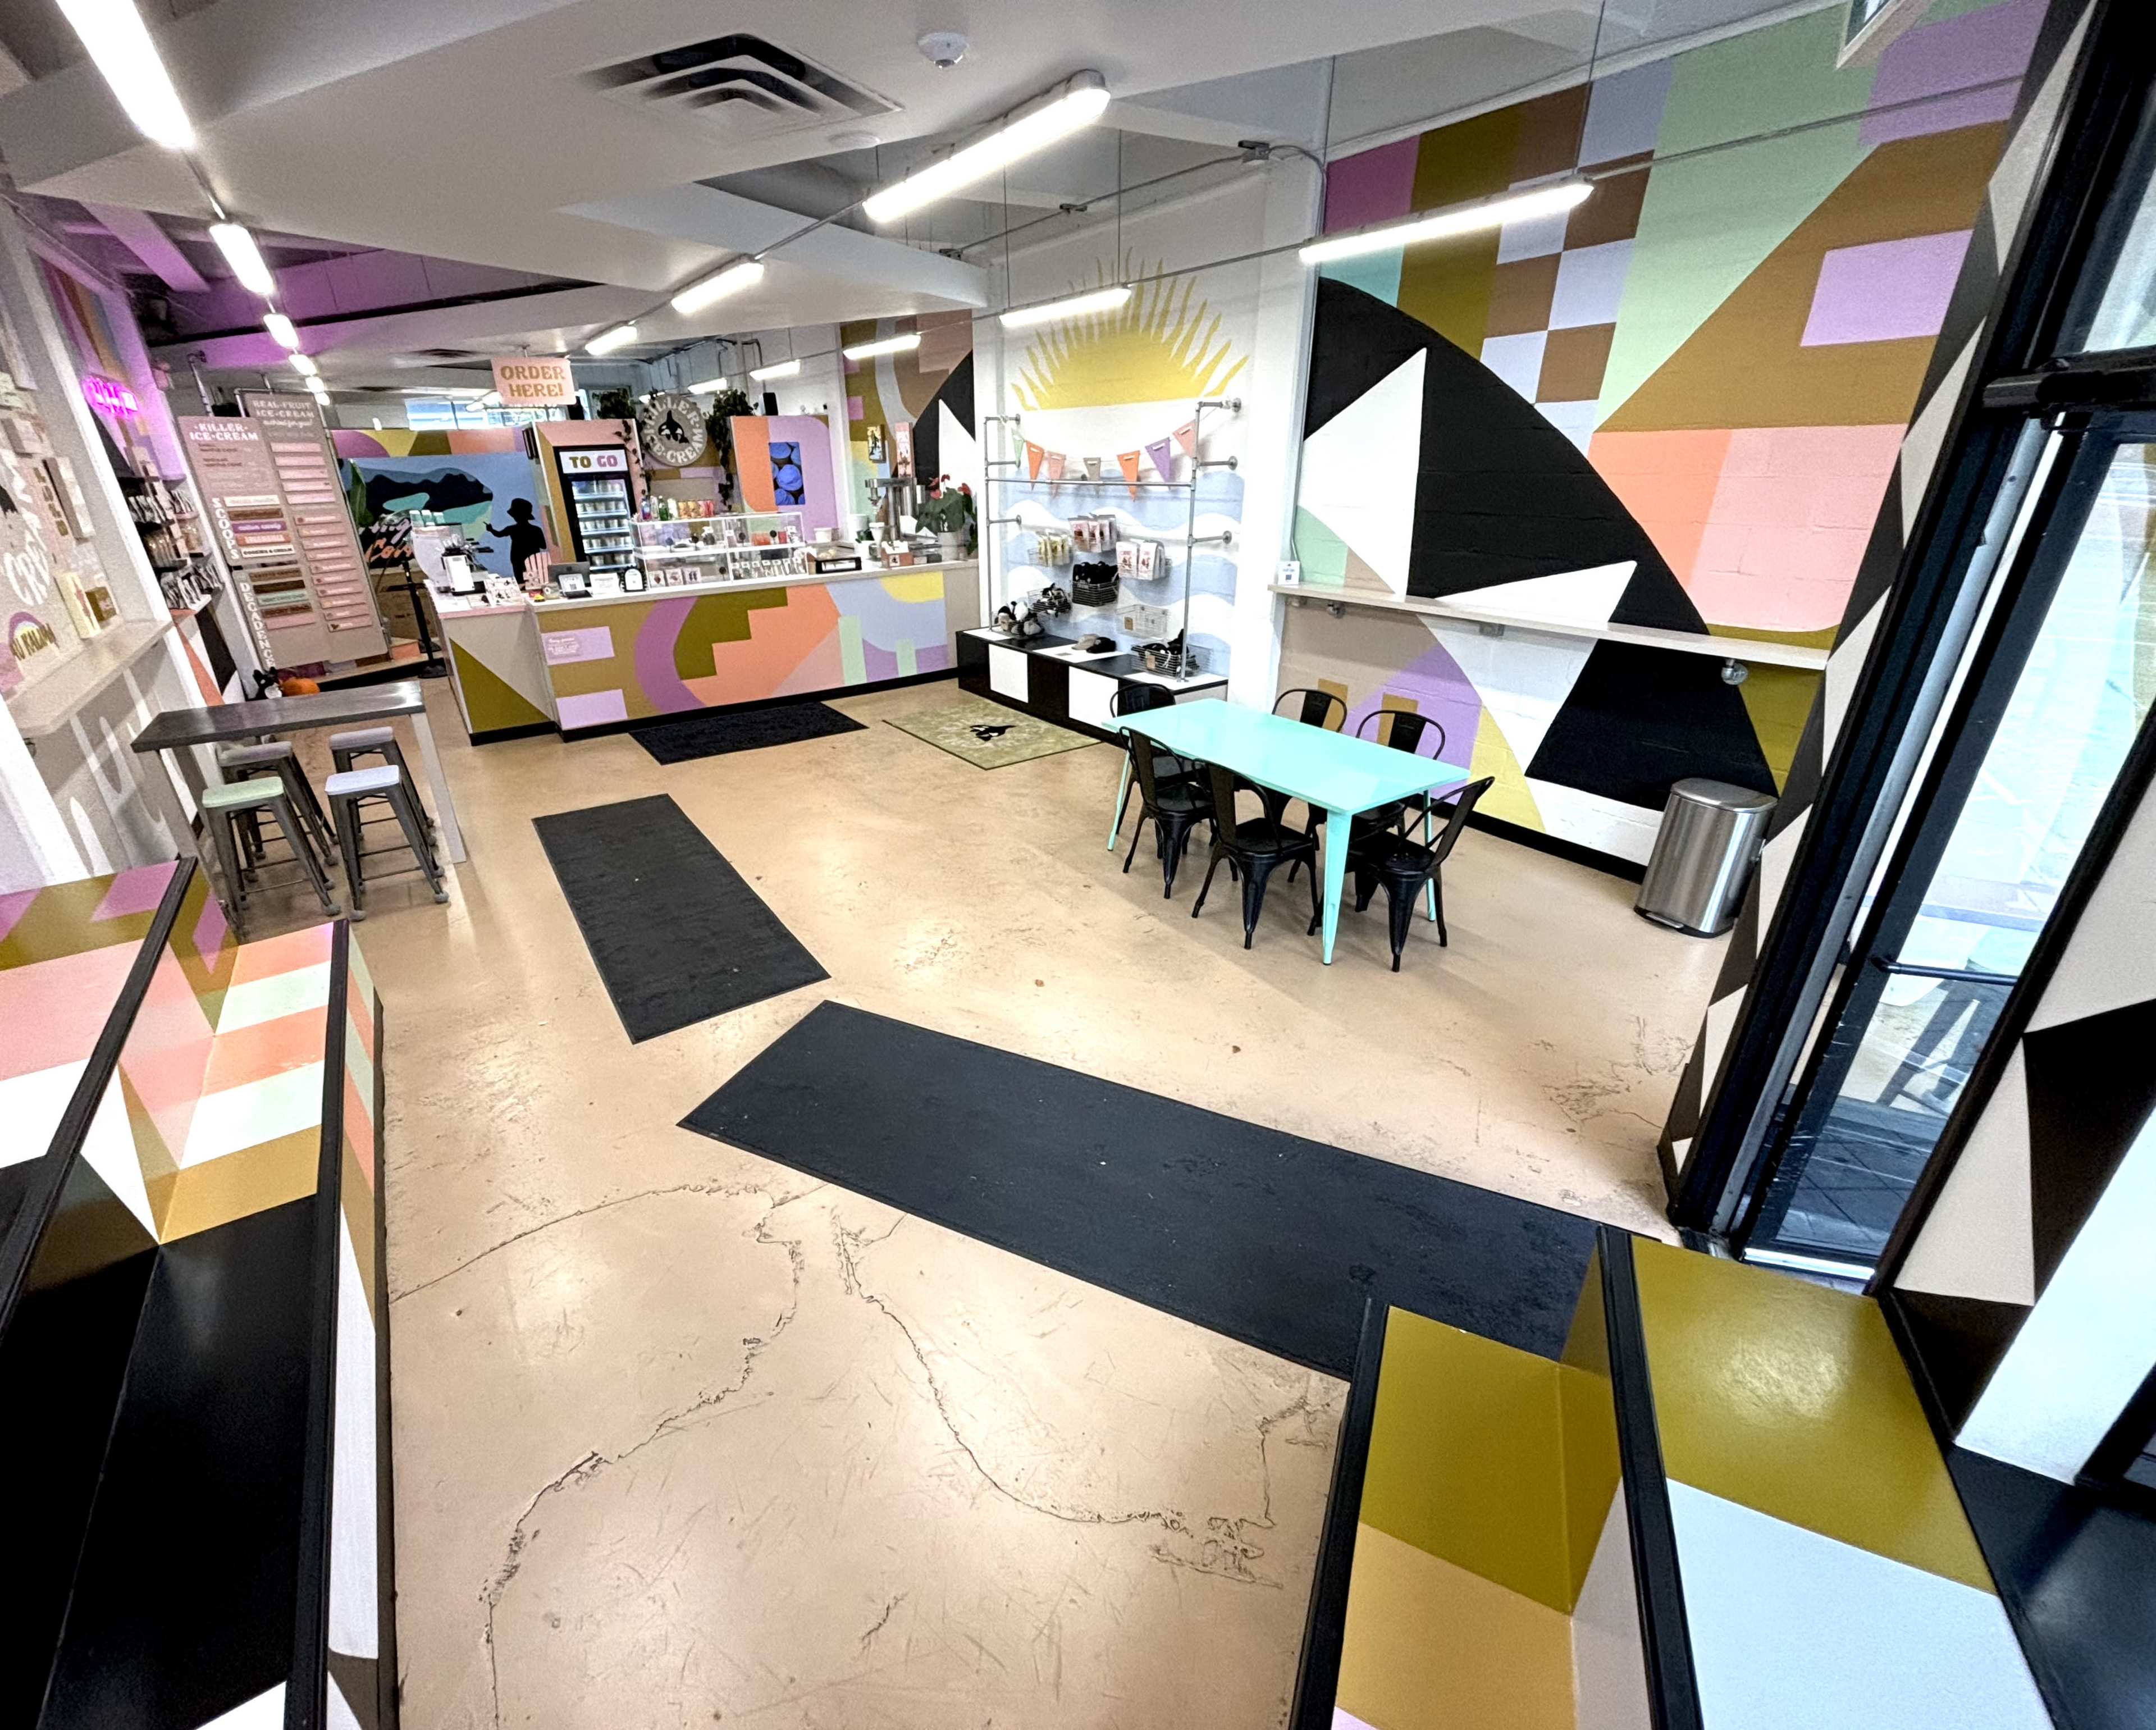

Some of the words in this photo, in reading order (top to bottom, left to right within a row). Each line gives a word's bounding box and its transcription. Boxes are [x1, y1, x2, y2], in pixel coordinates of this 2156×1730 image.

[501, 366, 566, 380] ORDER
[509, 383, 564, 397] HERE!
[569, 455, 592, 469] TO
[596, 454, 618, 468] GO
[211, 497, 240, 560] SCOOPS
[239, 582, 276, 668] DECADENCE
